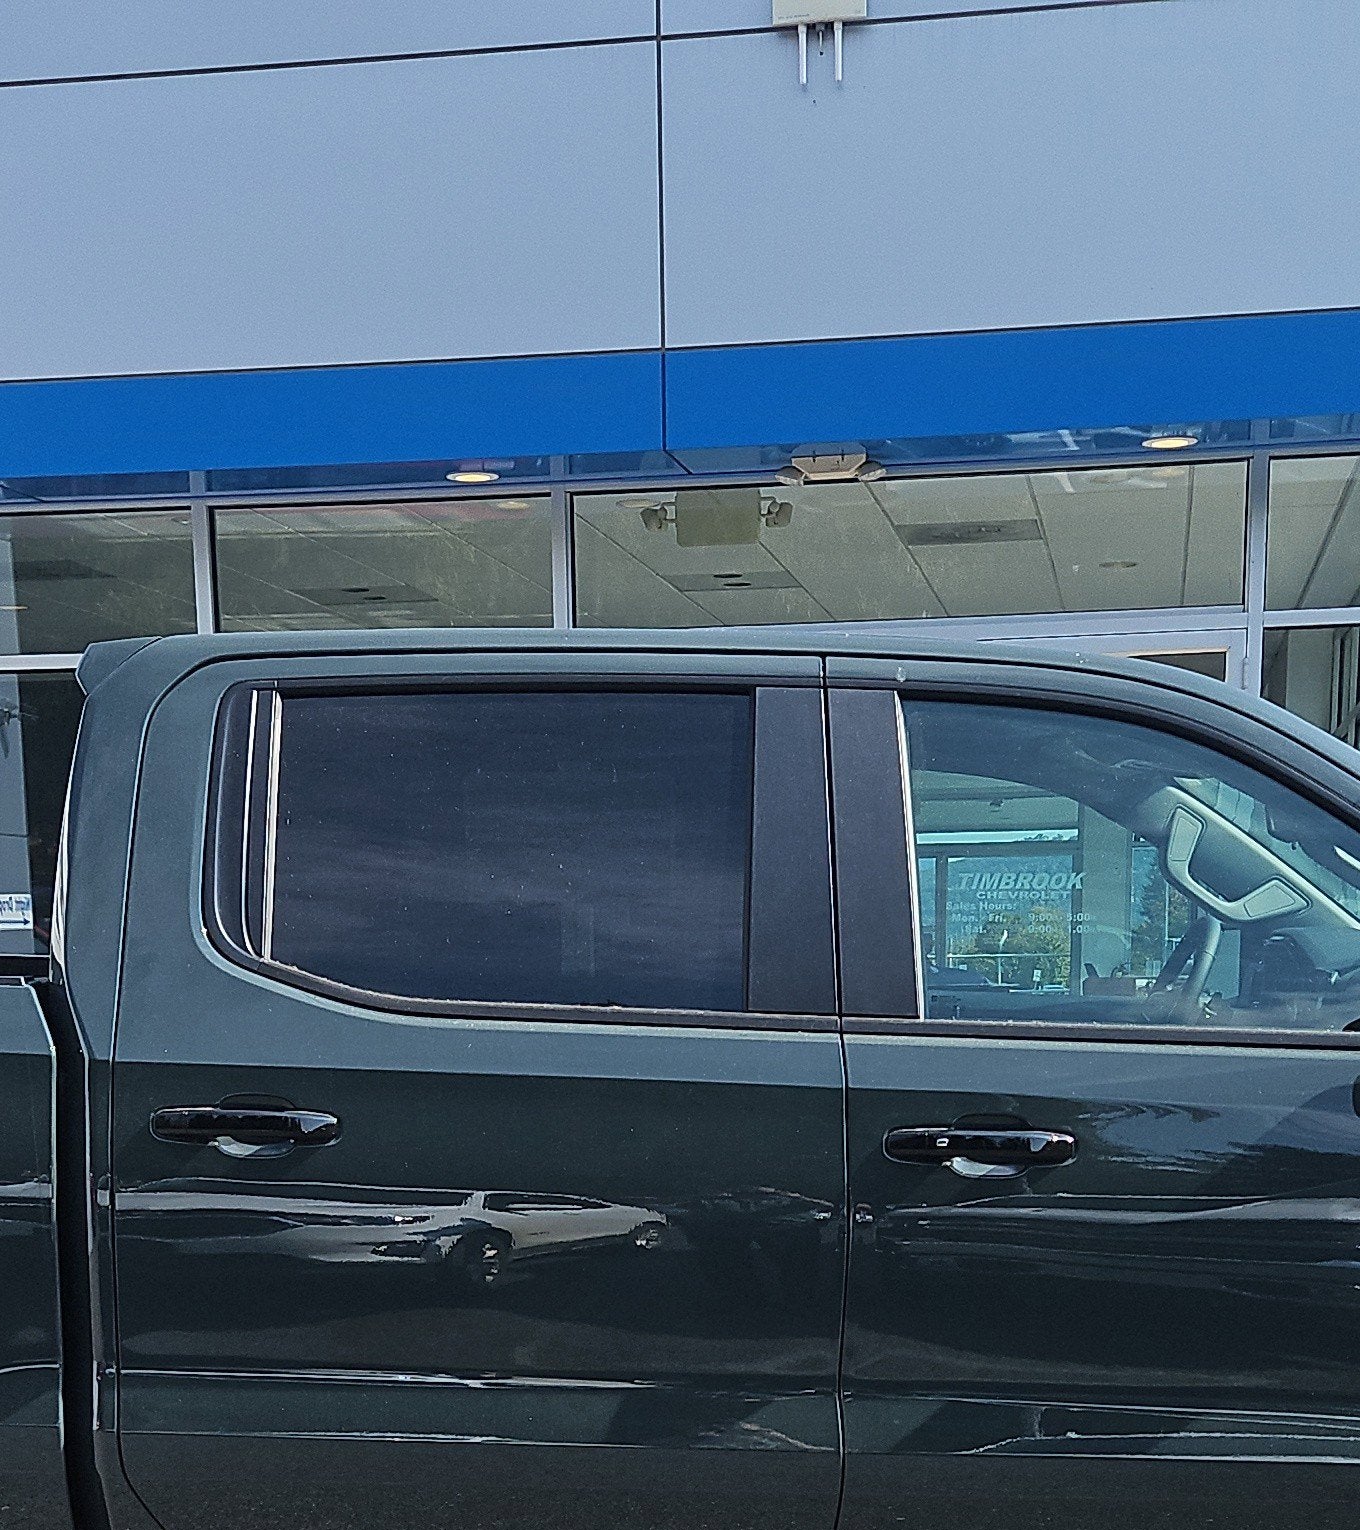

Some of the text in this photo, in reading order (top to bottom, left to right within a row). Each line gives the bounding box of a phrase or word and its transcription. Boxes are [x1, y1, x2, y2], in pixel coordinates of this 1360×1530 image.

[958, 872, 1086, 890] TIMBROOK
[976, 890, 1072, 899] CHEVROLET
[946, 901, 977, 911] Sales
